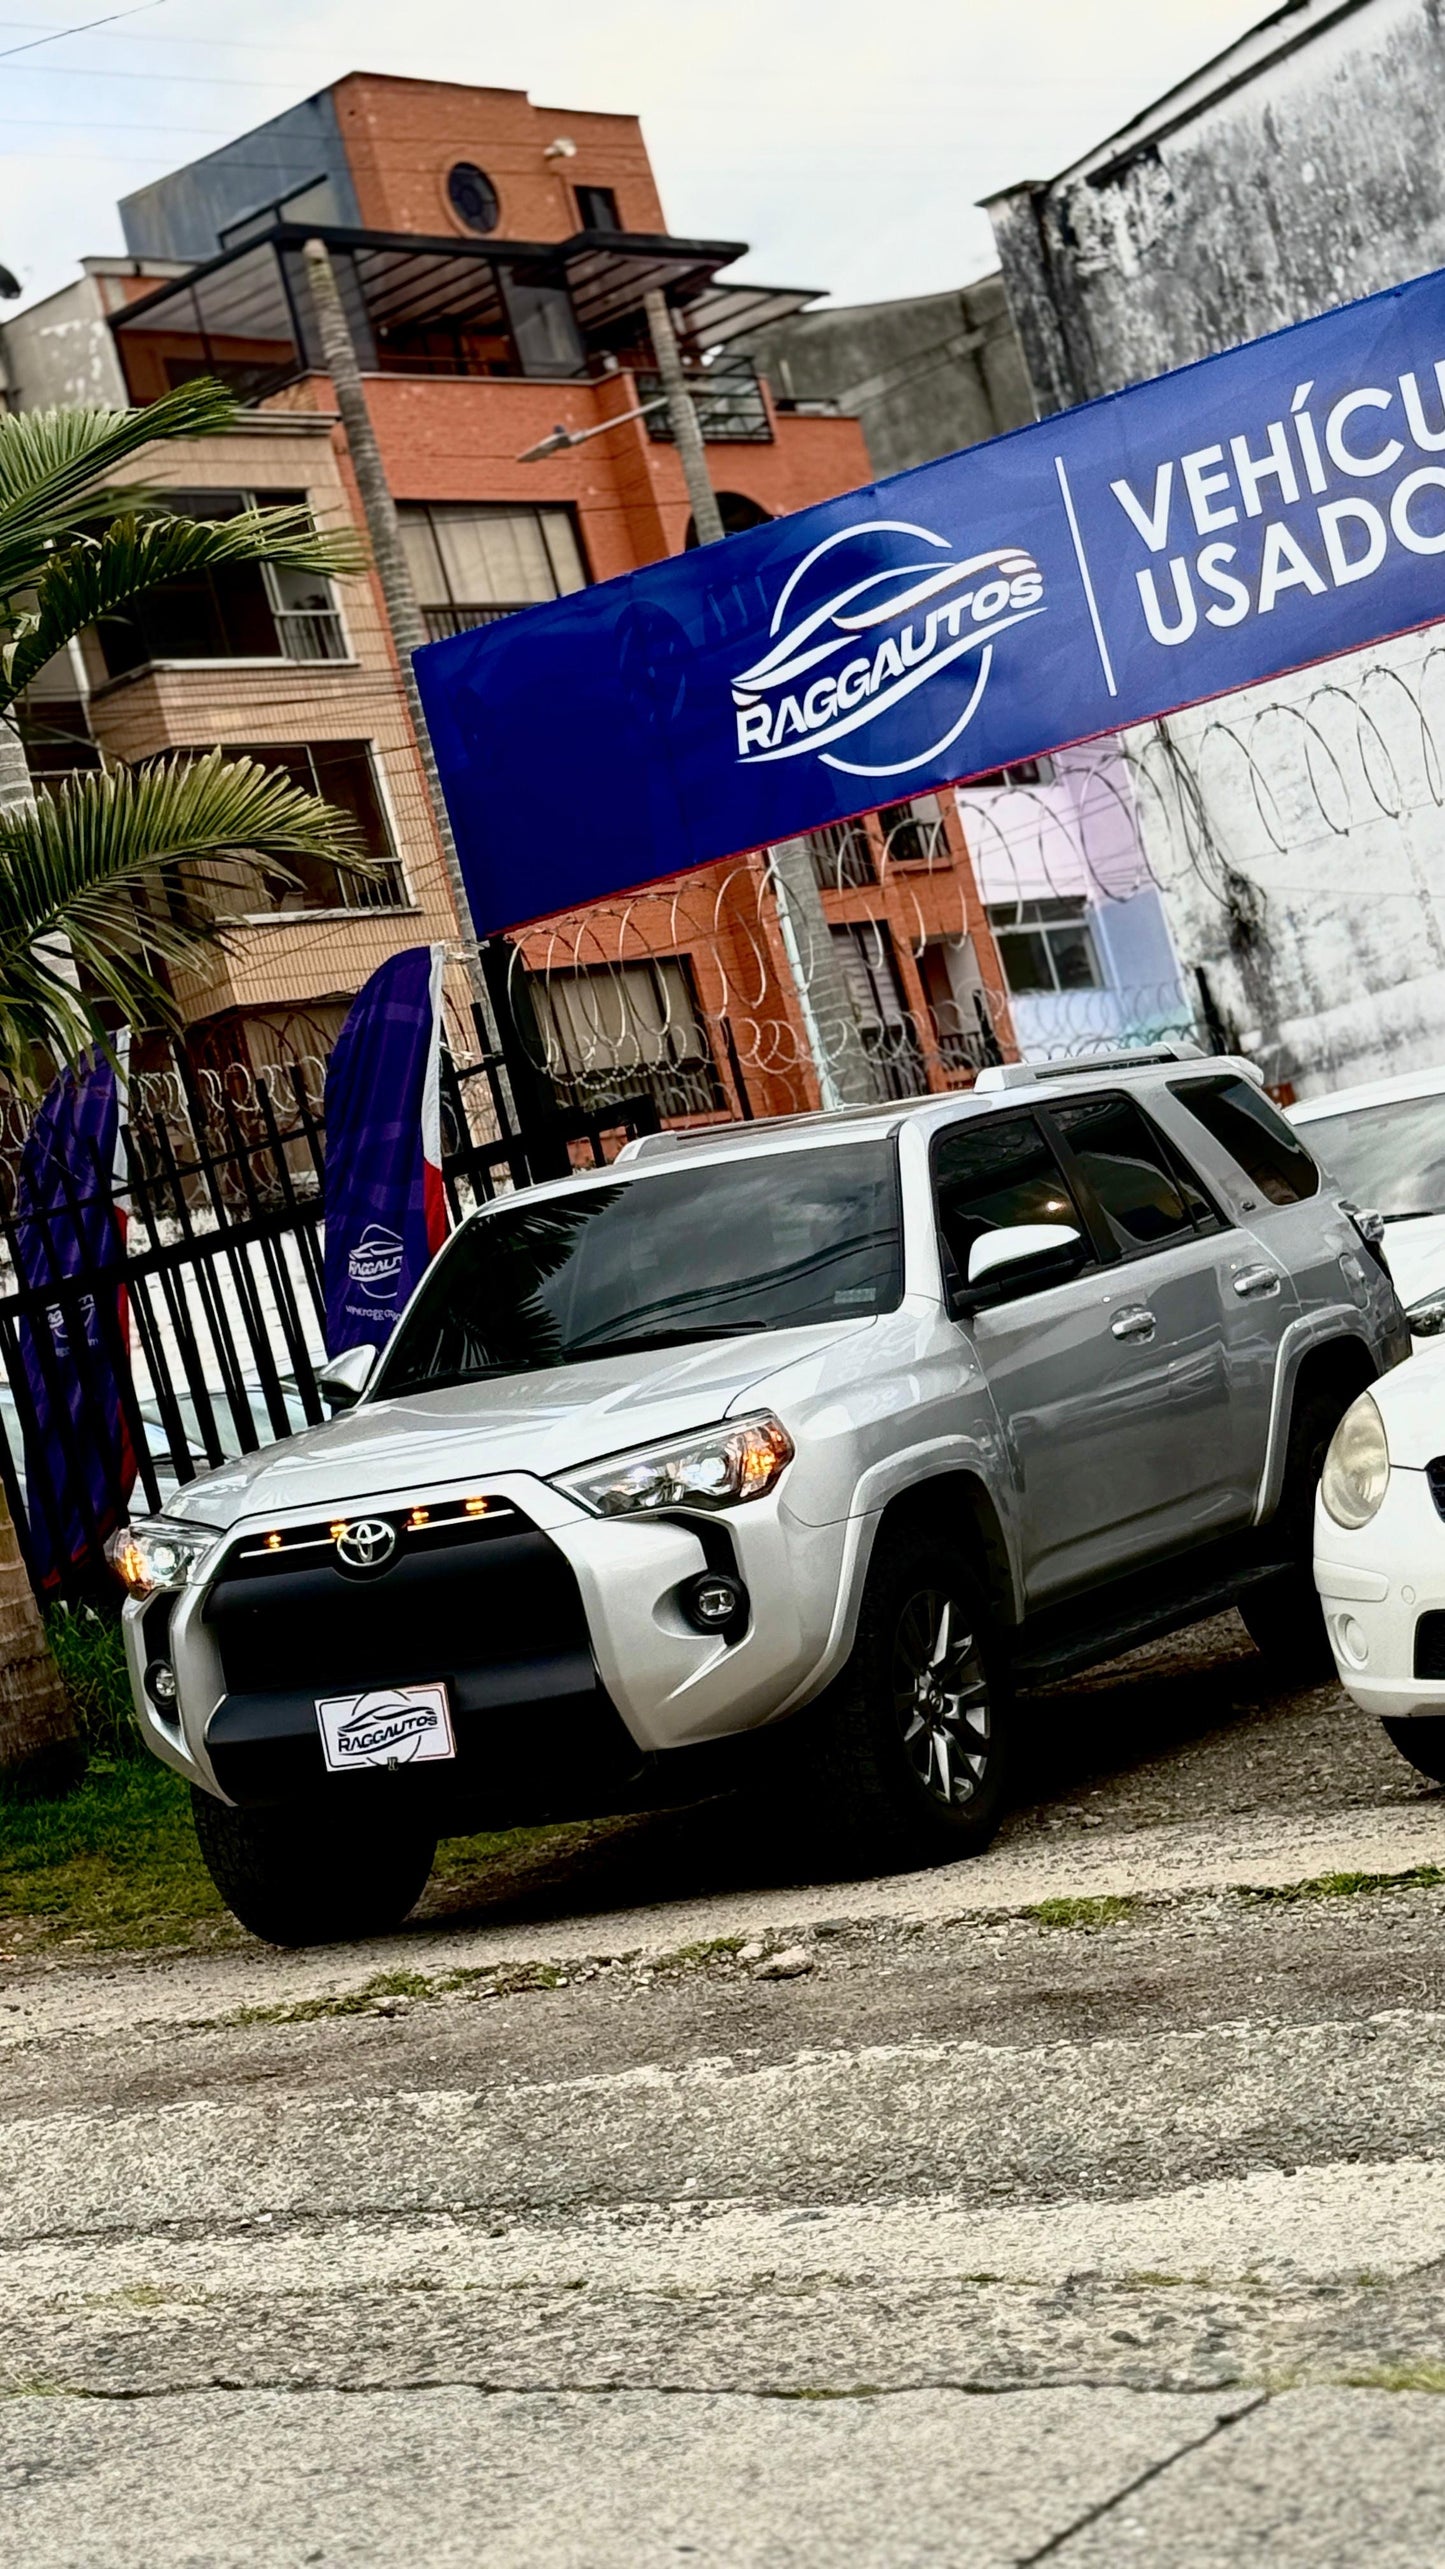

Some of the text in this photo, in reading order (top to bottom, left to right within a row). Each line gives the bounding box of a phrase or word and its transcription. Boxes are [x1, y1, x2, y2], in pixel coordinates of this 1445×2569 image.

[1111, 360, 1445, 553] VEHÍCU
[1136, 466, 1445, 646] USADO
[736, 572, 1044, 756] RAGGAUTOS
[348, 1255, 403, 1276] RAGGAUT
[338, 1715, 438, 1753] RAGGAUTOS
